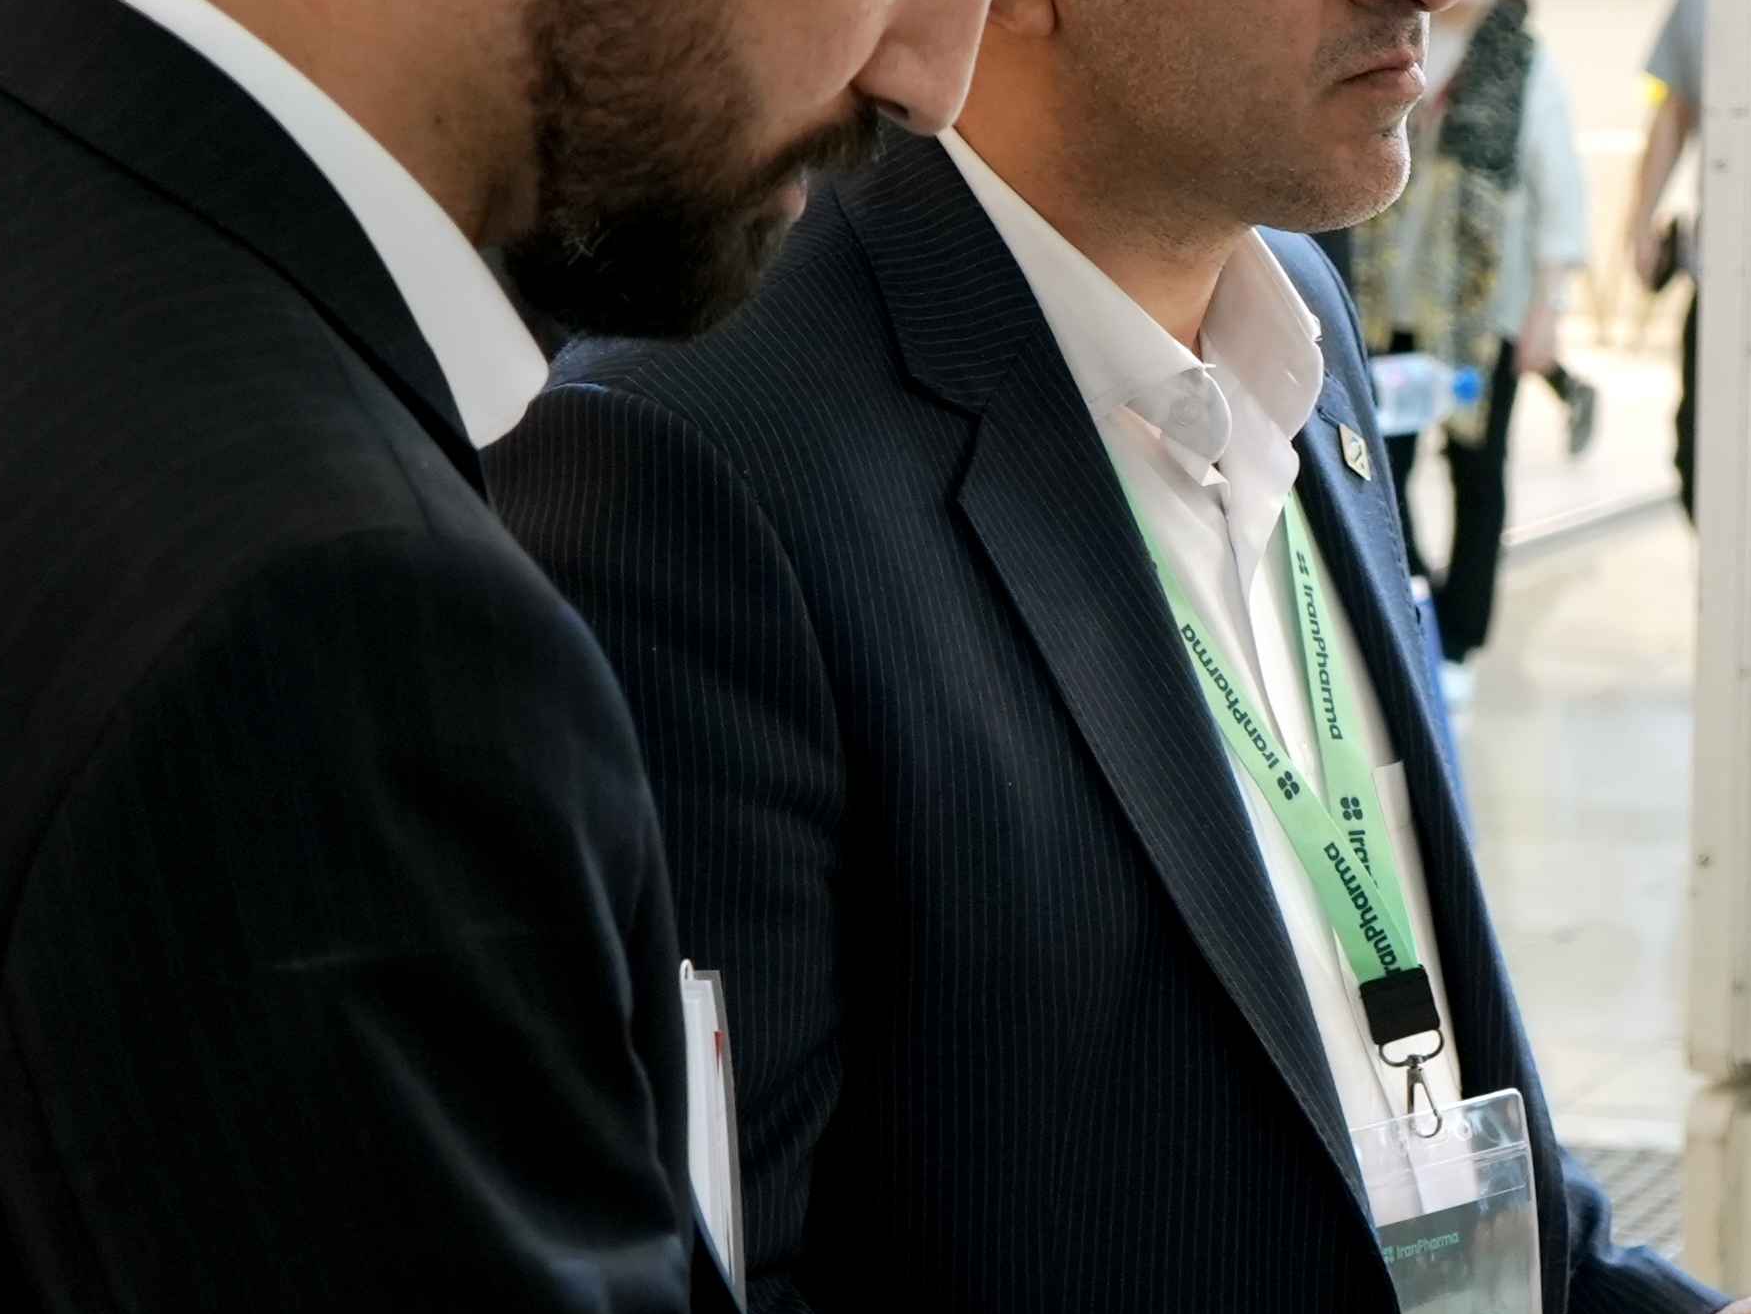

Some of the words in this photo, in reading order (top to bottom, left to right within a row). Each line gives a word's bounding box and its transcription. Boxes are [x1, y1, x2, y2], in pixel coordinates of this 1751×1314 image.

[1181, 623, 1280, 770] IranPharma
[1303, 584, 1343, 740] IranPharma
[1323, 841, 1402, 977] ranPharma
